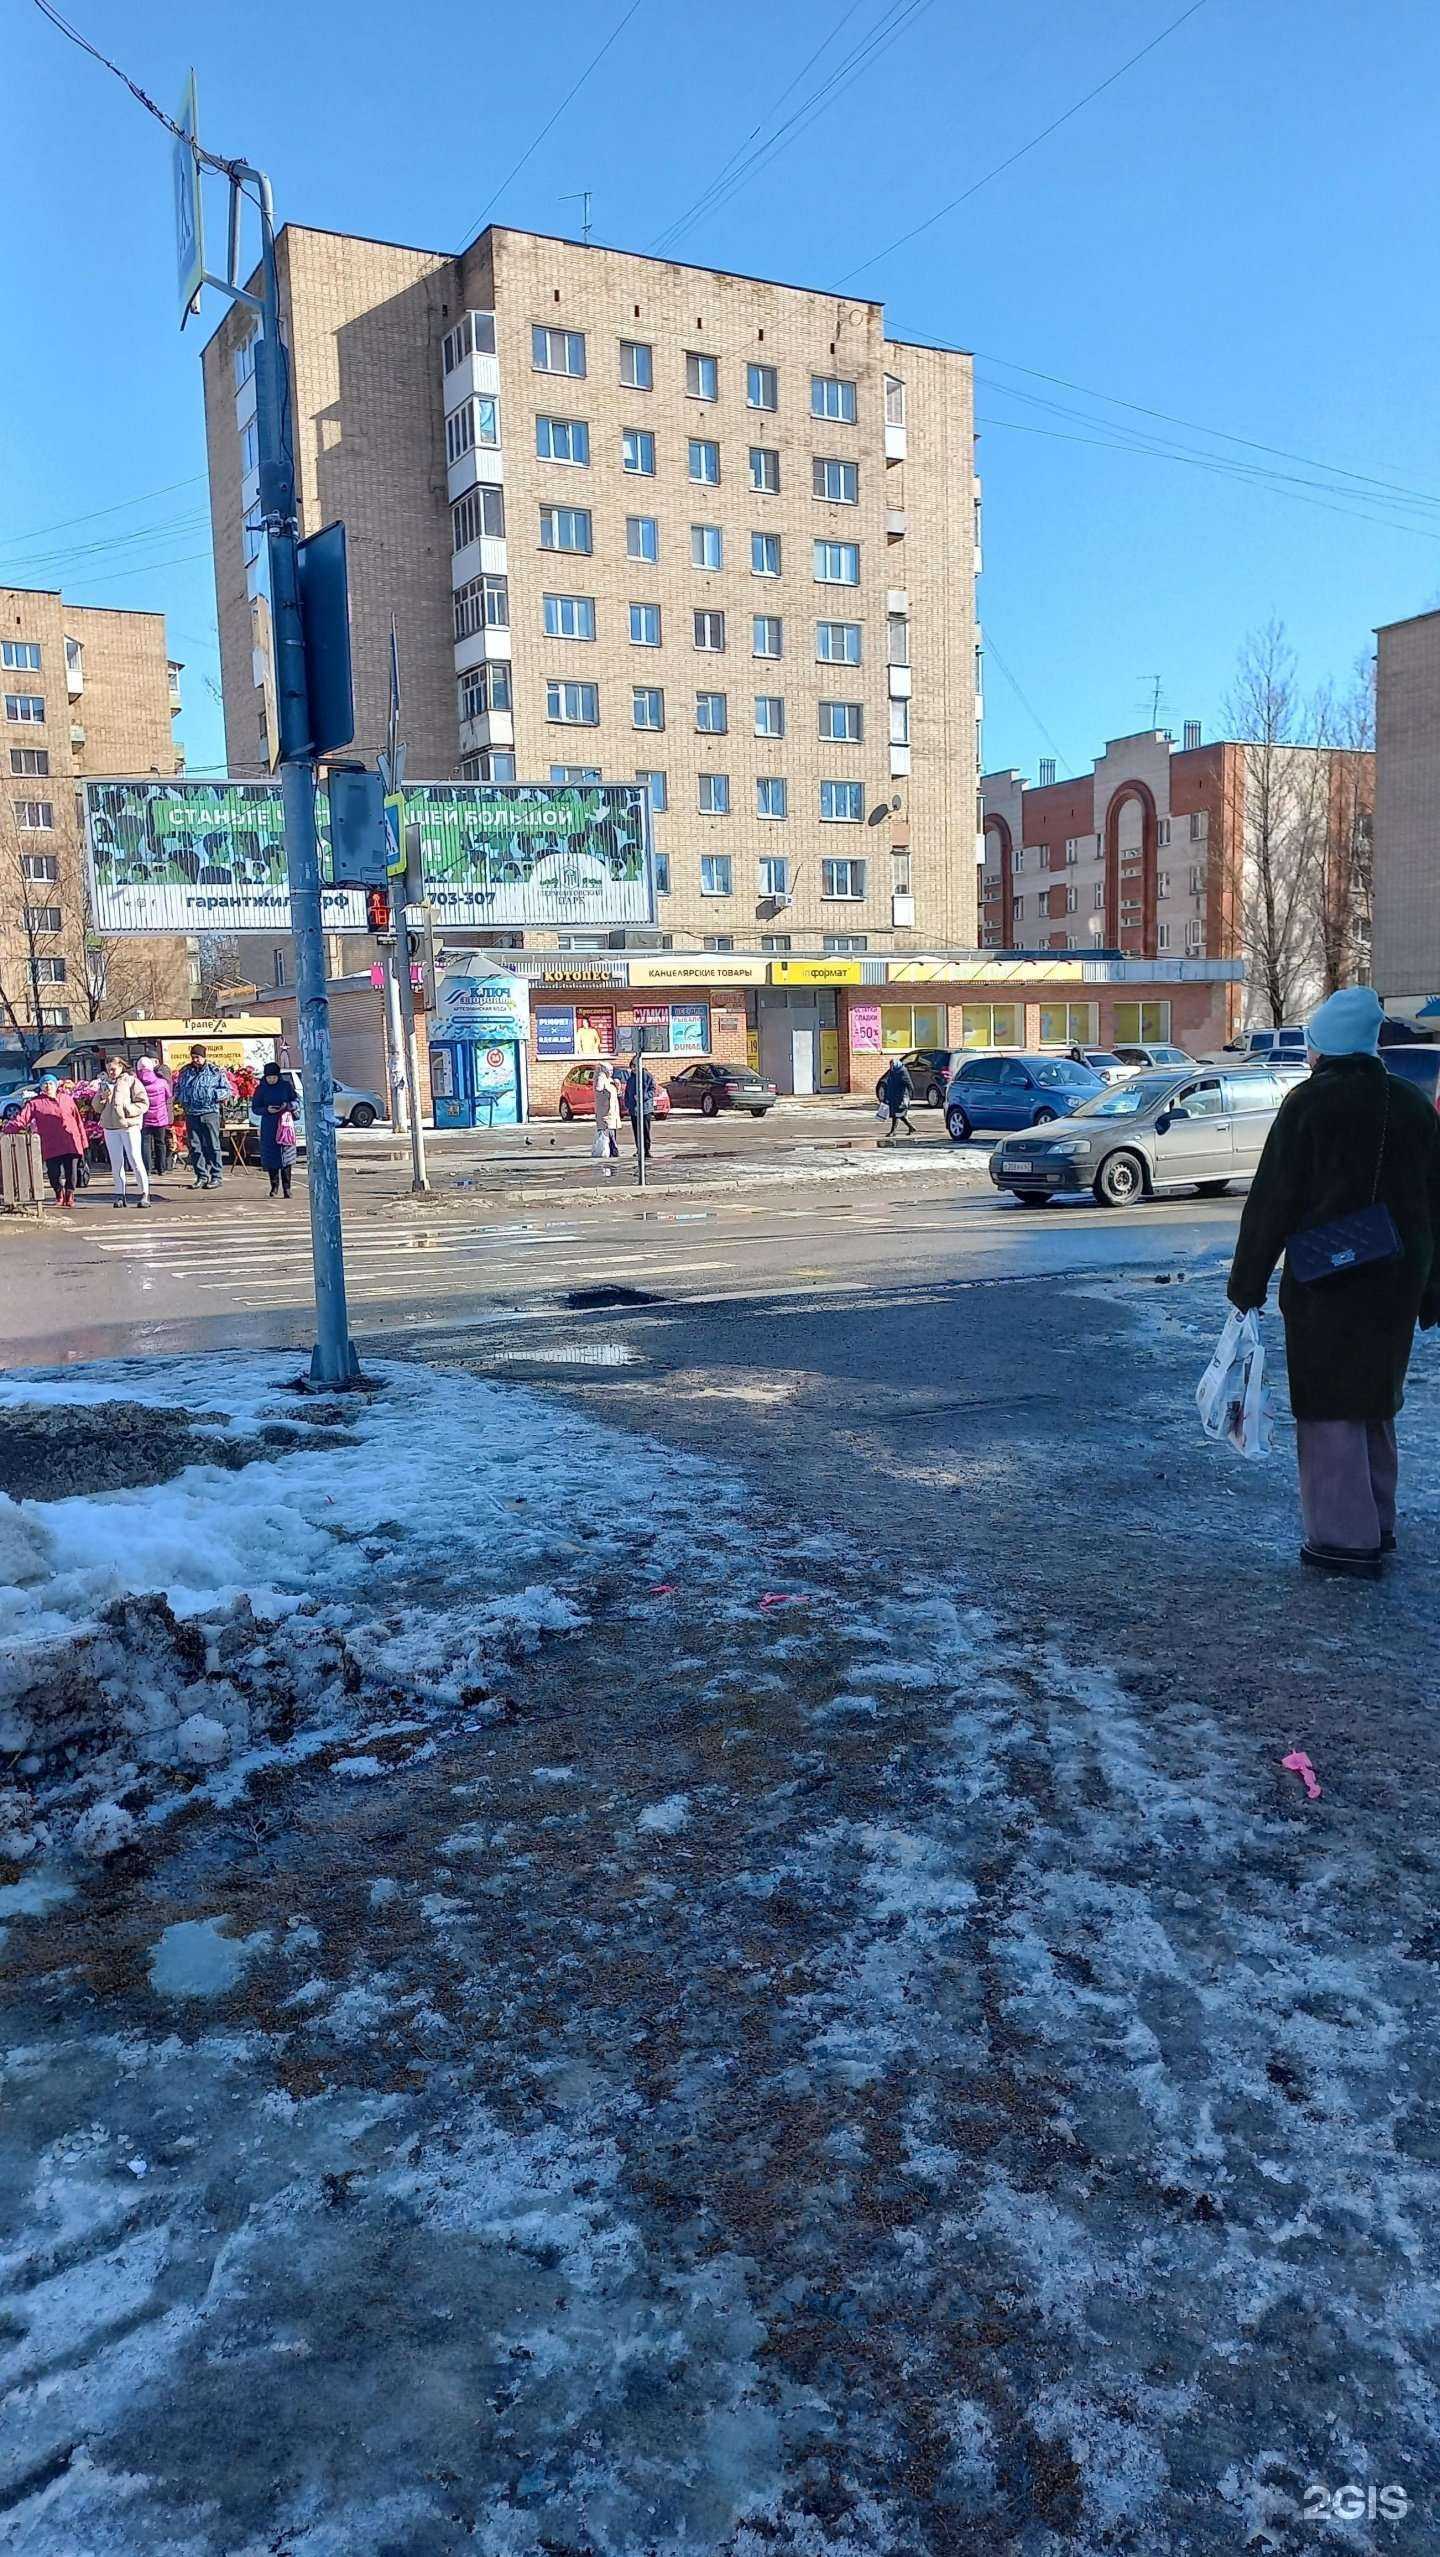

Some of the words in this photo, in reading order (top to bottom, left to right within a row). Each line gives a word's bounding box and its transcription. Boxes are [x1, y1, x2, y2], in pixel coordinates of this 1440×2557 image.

[168, 808, 271, 825] СТАНЬТЕ
[464, 805, 572, 825] БОЛЬШОЙ
[543, 970, 610, 982] КОТОПЕС
[648, 968, 715, 977] КАНЦЕЛЯРСКИЕ
[717, 969, 753, 977] ТОВАРЫ
[469, 987, 511, 998] КЛЮЧ
[633, 1008, 668, 1023] СУМКИ
